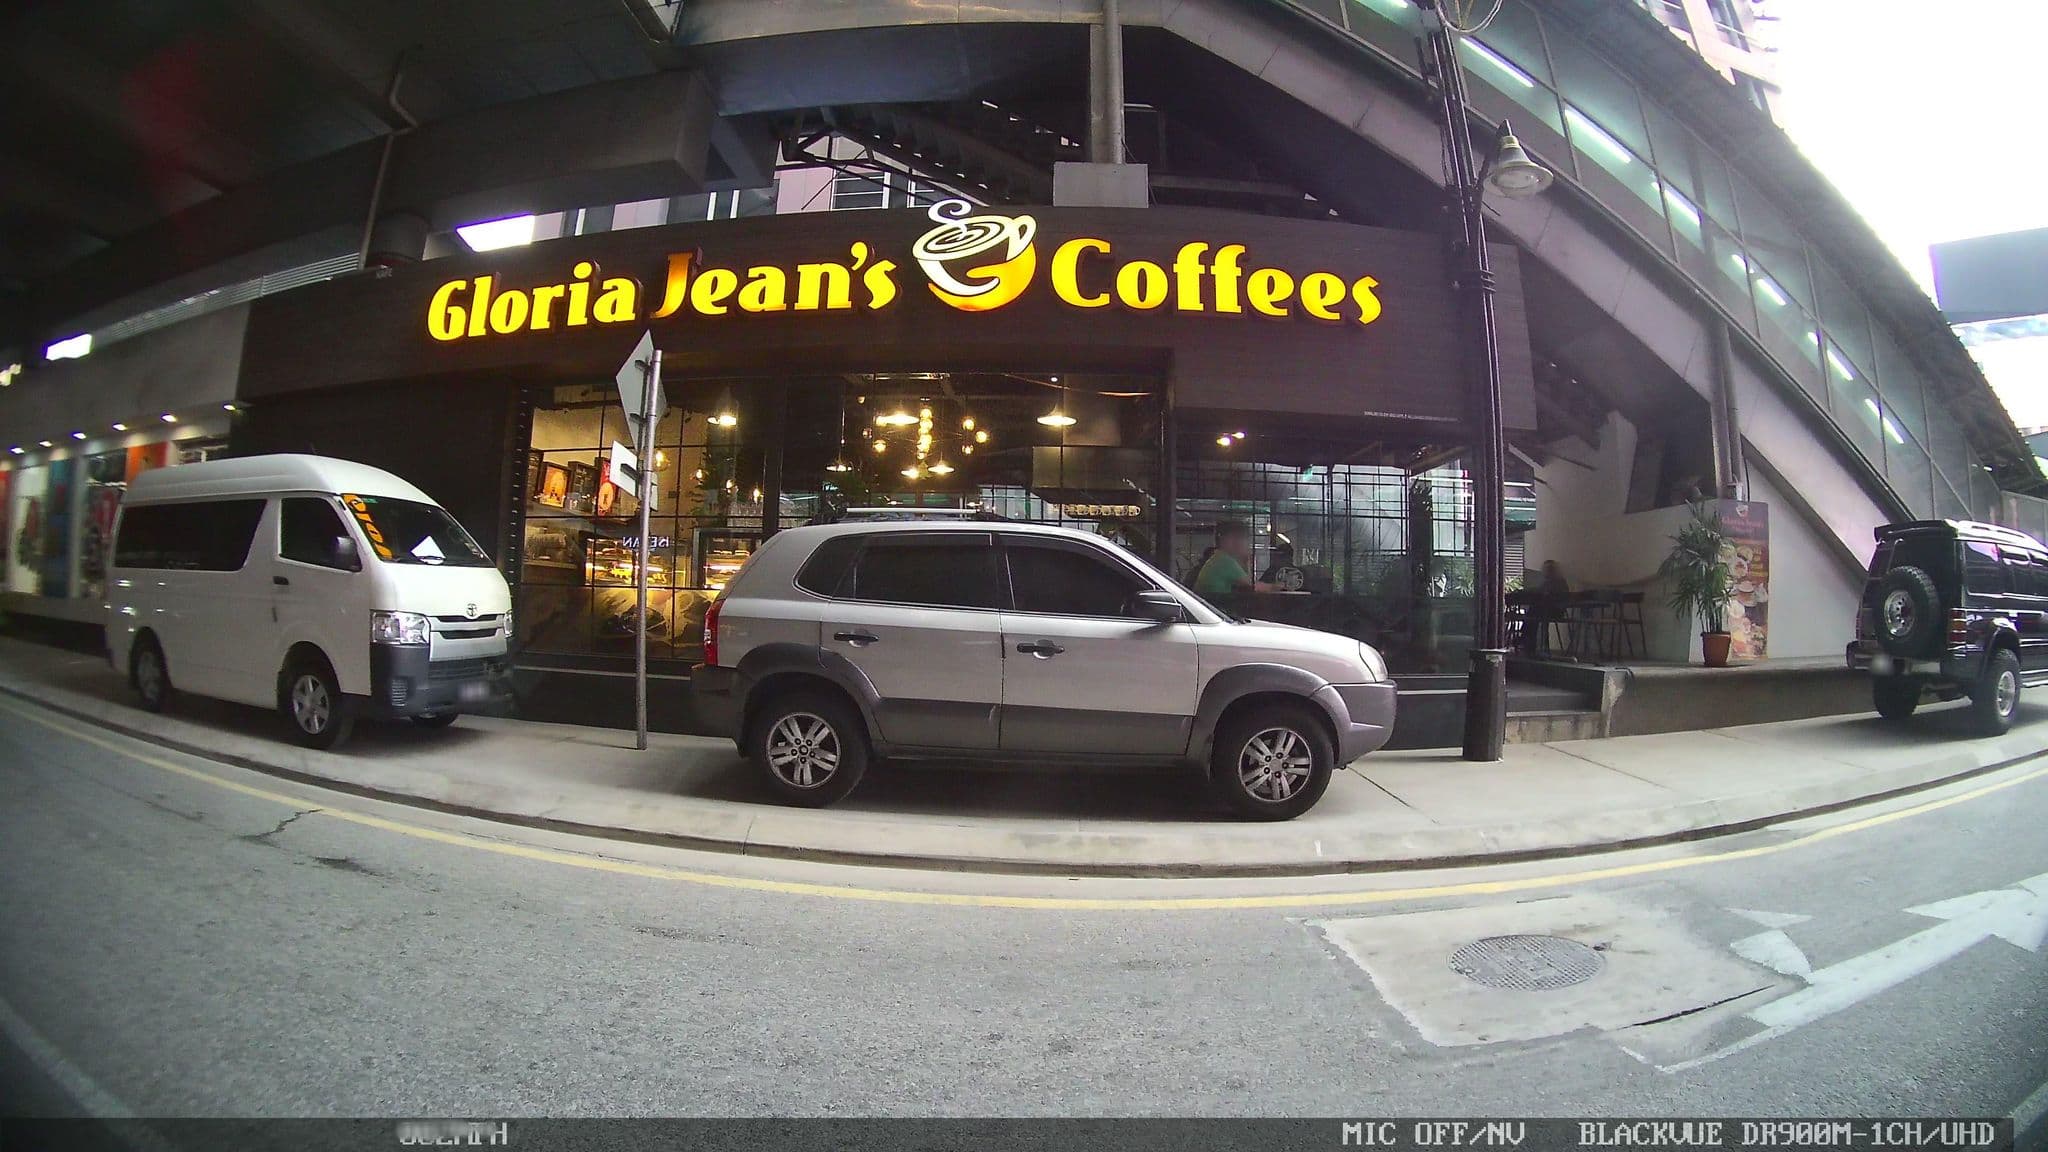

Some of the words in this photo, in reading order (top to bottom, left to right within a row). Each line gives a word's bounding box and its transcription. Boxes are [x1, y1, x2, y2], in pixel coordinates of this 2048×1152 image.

[427, 261, 636, 341] Gloria
[650, 241, 897, 320] Jean's
[1050, 237, 1383, 325] Coffees
